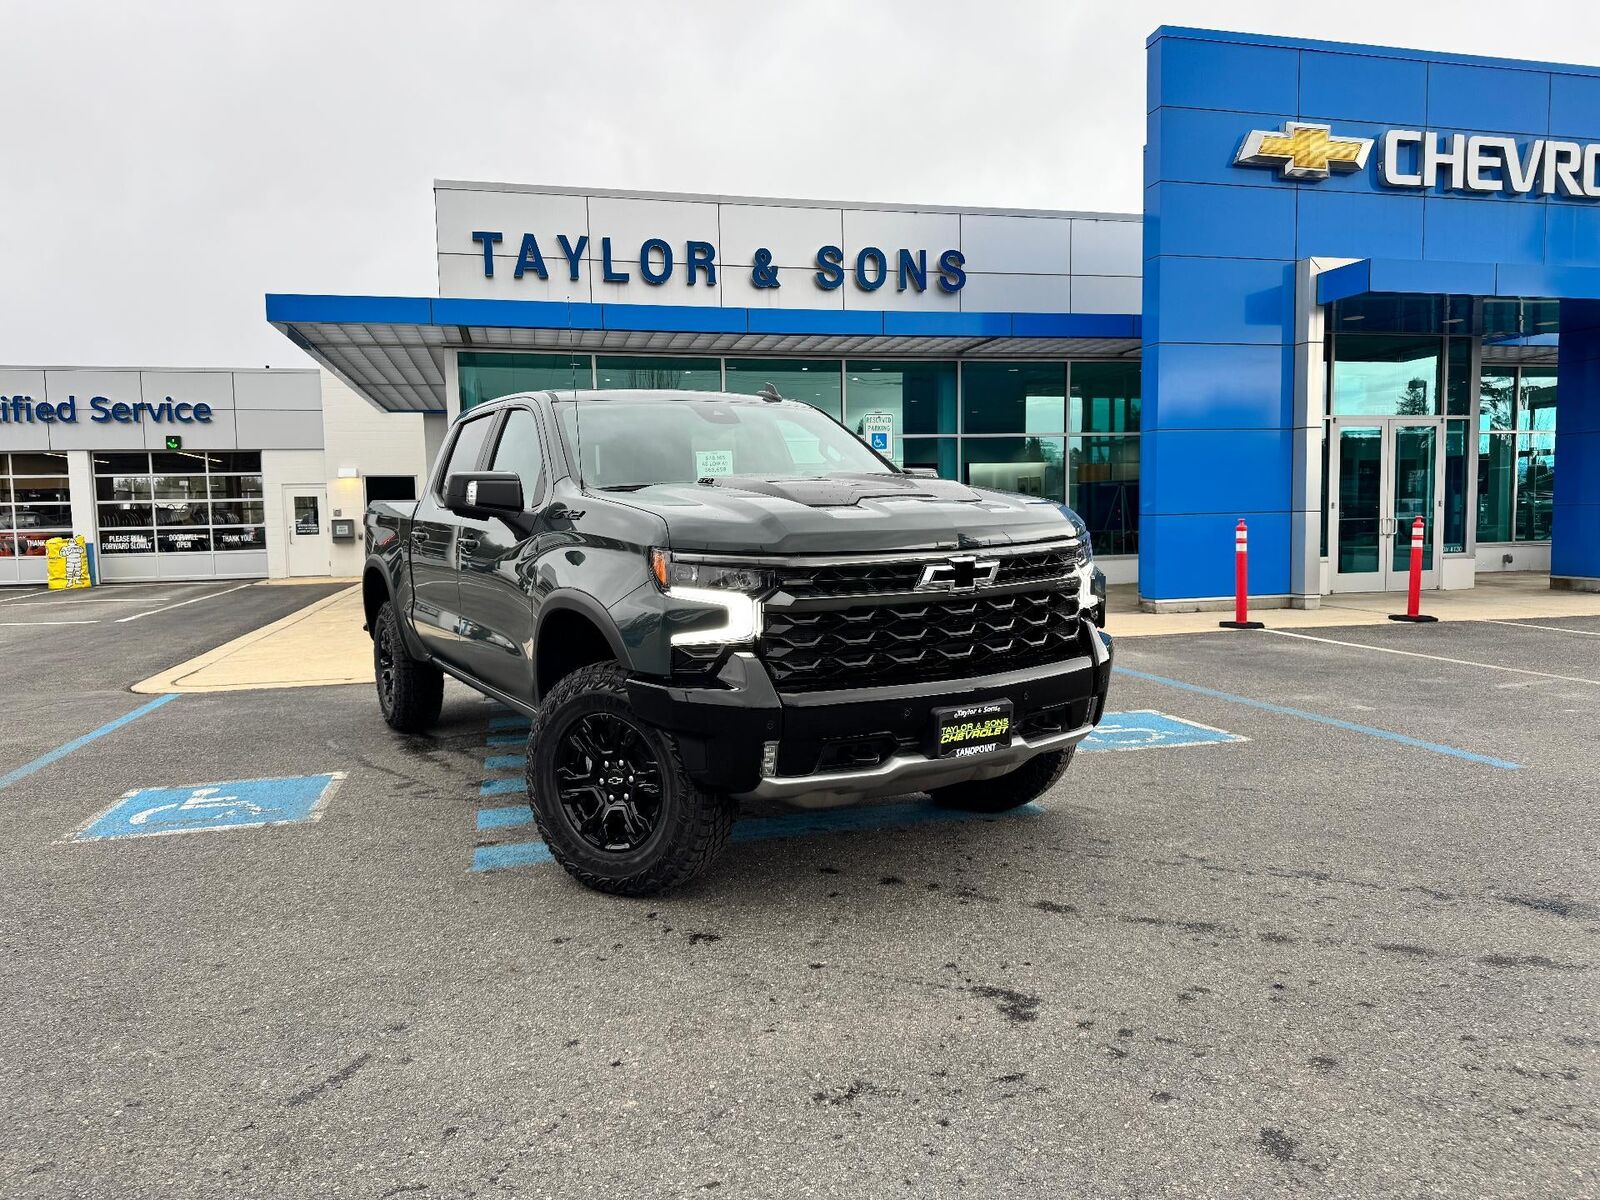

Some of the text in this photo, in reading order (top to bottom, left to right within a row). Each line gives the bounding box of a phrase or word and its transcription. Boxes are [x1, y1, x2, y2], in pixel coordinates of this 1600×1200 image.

[472, 231, 966, 293] TAYLOR & SONS
[0, 396, 212, 423] ified Service
[954, 708, 977, 718] Taylor
[940, 726, 1008, 744] CHEVROLET
[941, 723, 974, 734] TAYLOR
[984, 718, 1009, 728] SONS
